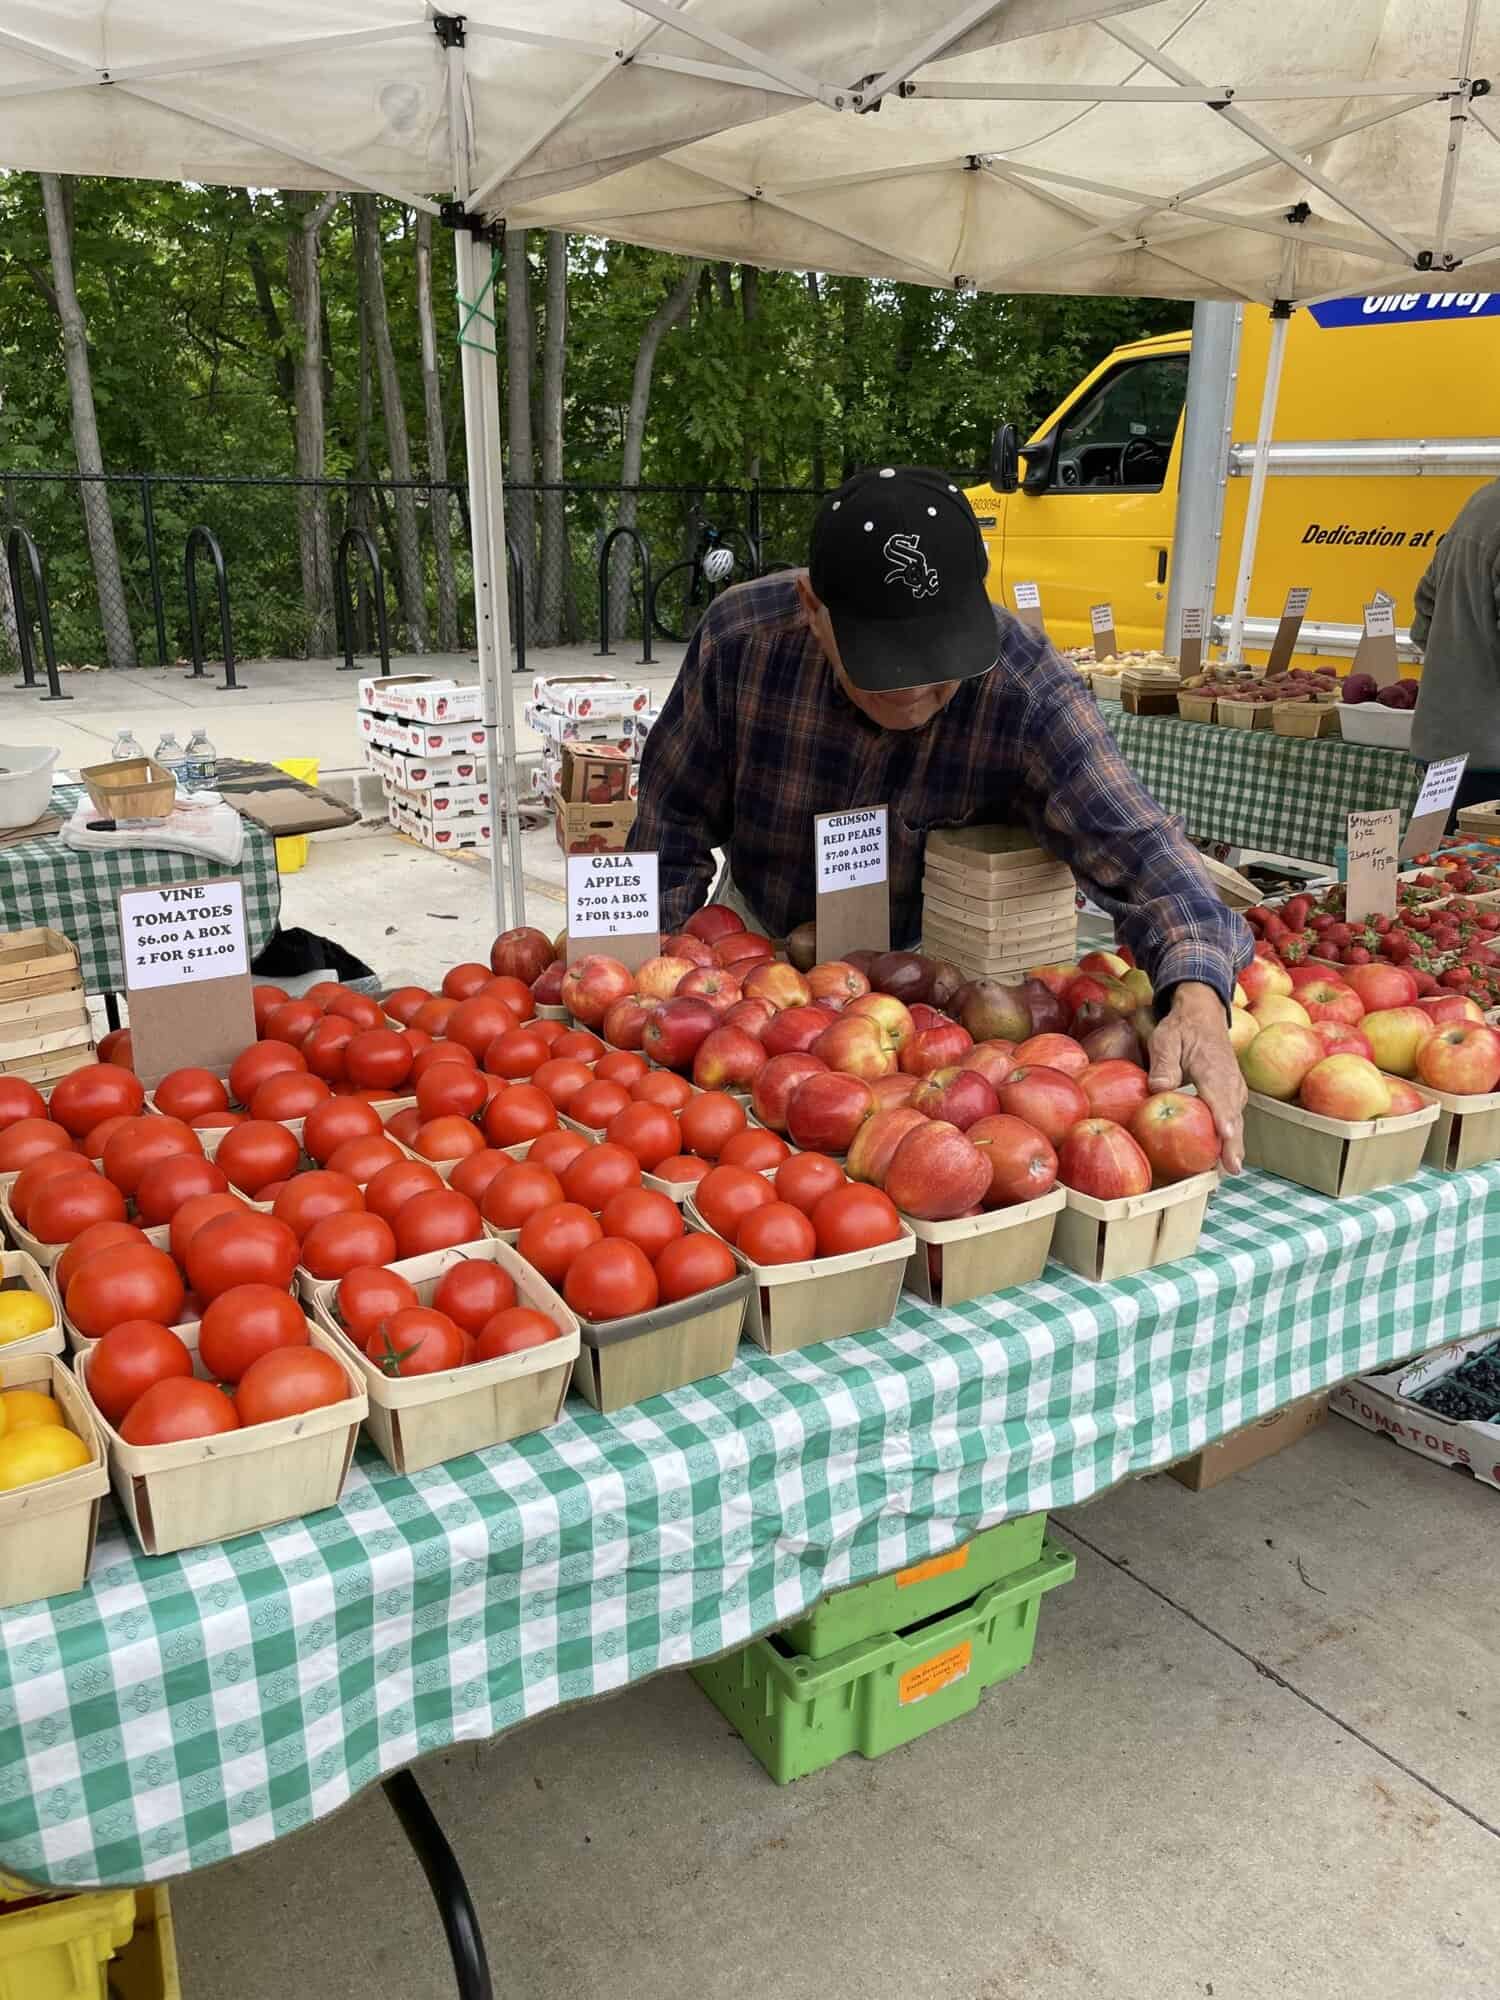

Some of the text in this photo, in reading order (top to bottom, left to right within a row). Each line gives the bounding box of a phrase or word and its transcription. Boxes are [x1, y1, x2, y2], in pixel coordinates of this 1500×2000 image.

[1302, 525, 1406, 546] Dedication
[1409, 530, 1435, 547] at
[828, 812, 877, 828] CRIMSON
[823, 826, 882, 845] RED PEARS
[825, 842, 879, 860] $7.00 A BOX
[591, 856, 633, 869] GALA
[824, 858, 881, 875] 2 FOR $13.00
[584, 875, 641, 889] APPLES
[160, 887, 206, 902] VINE
[577, 893, 648, 906] $7.00 A BOX
[132, 904, 233, 927] TOMATOES
[585, 911, 610, 921] FOR
[613, 910, 649, 920] $13.00
[138, 924, 232, 947] $6.00 A BOX
[136, 944, 235, 965] 2 FOR $11.00
[1347, 1393, 1472, 1463] TOMATOES
